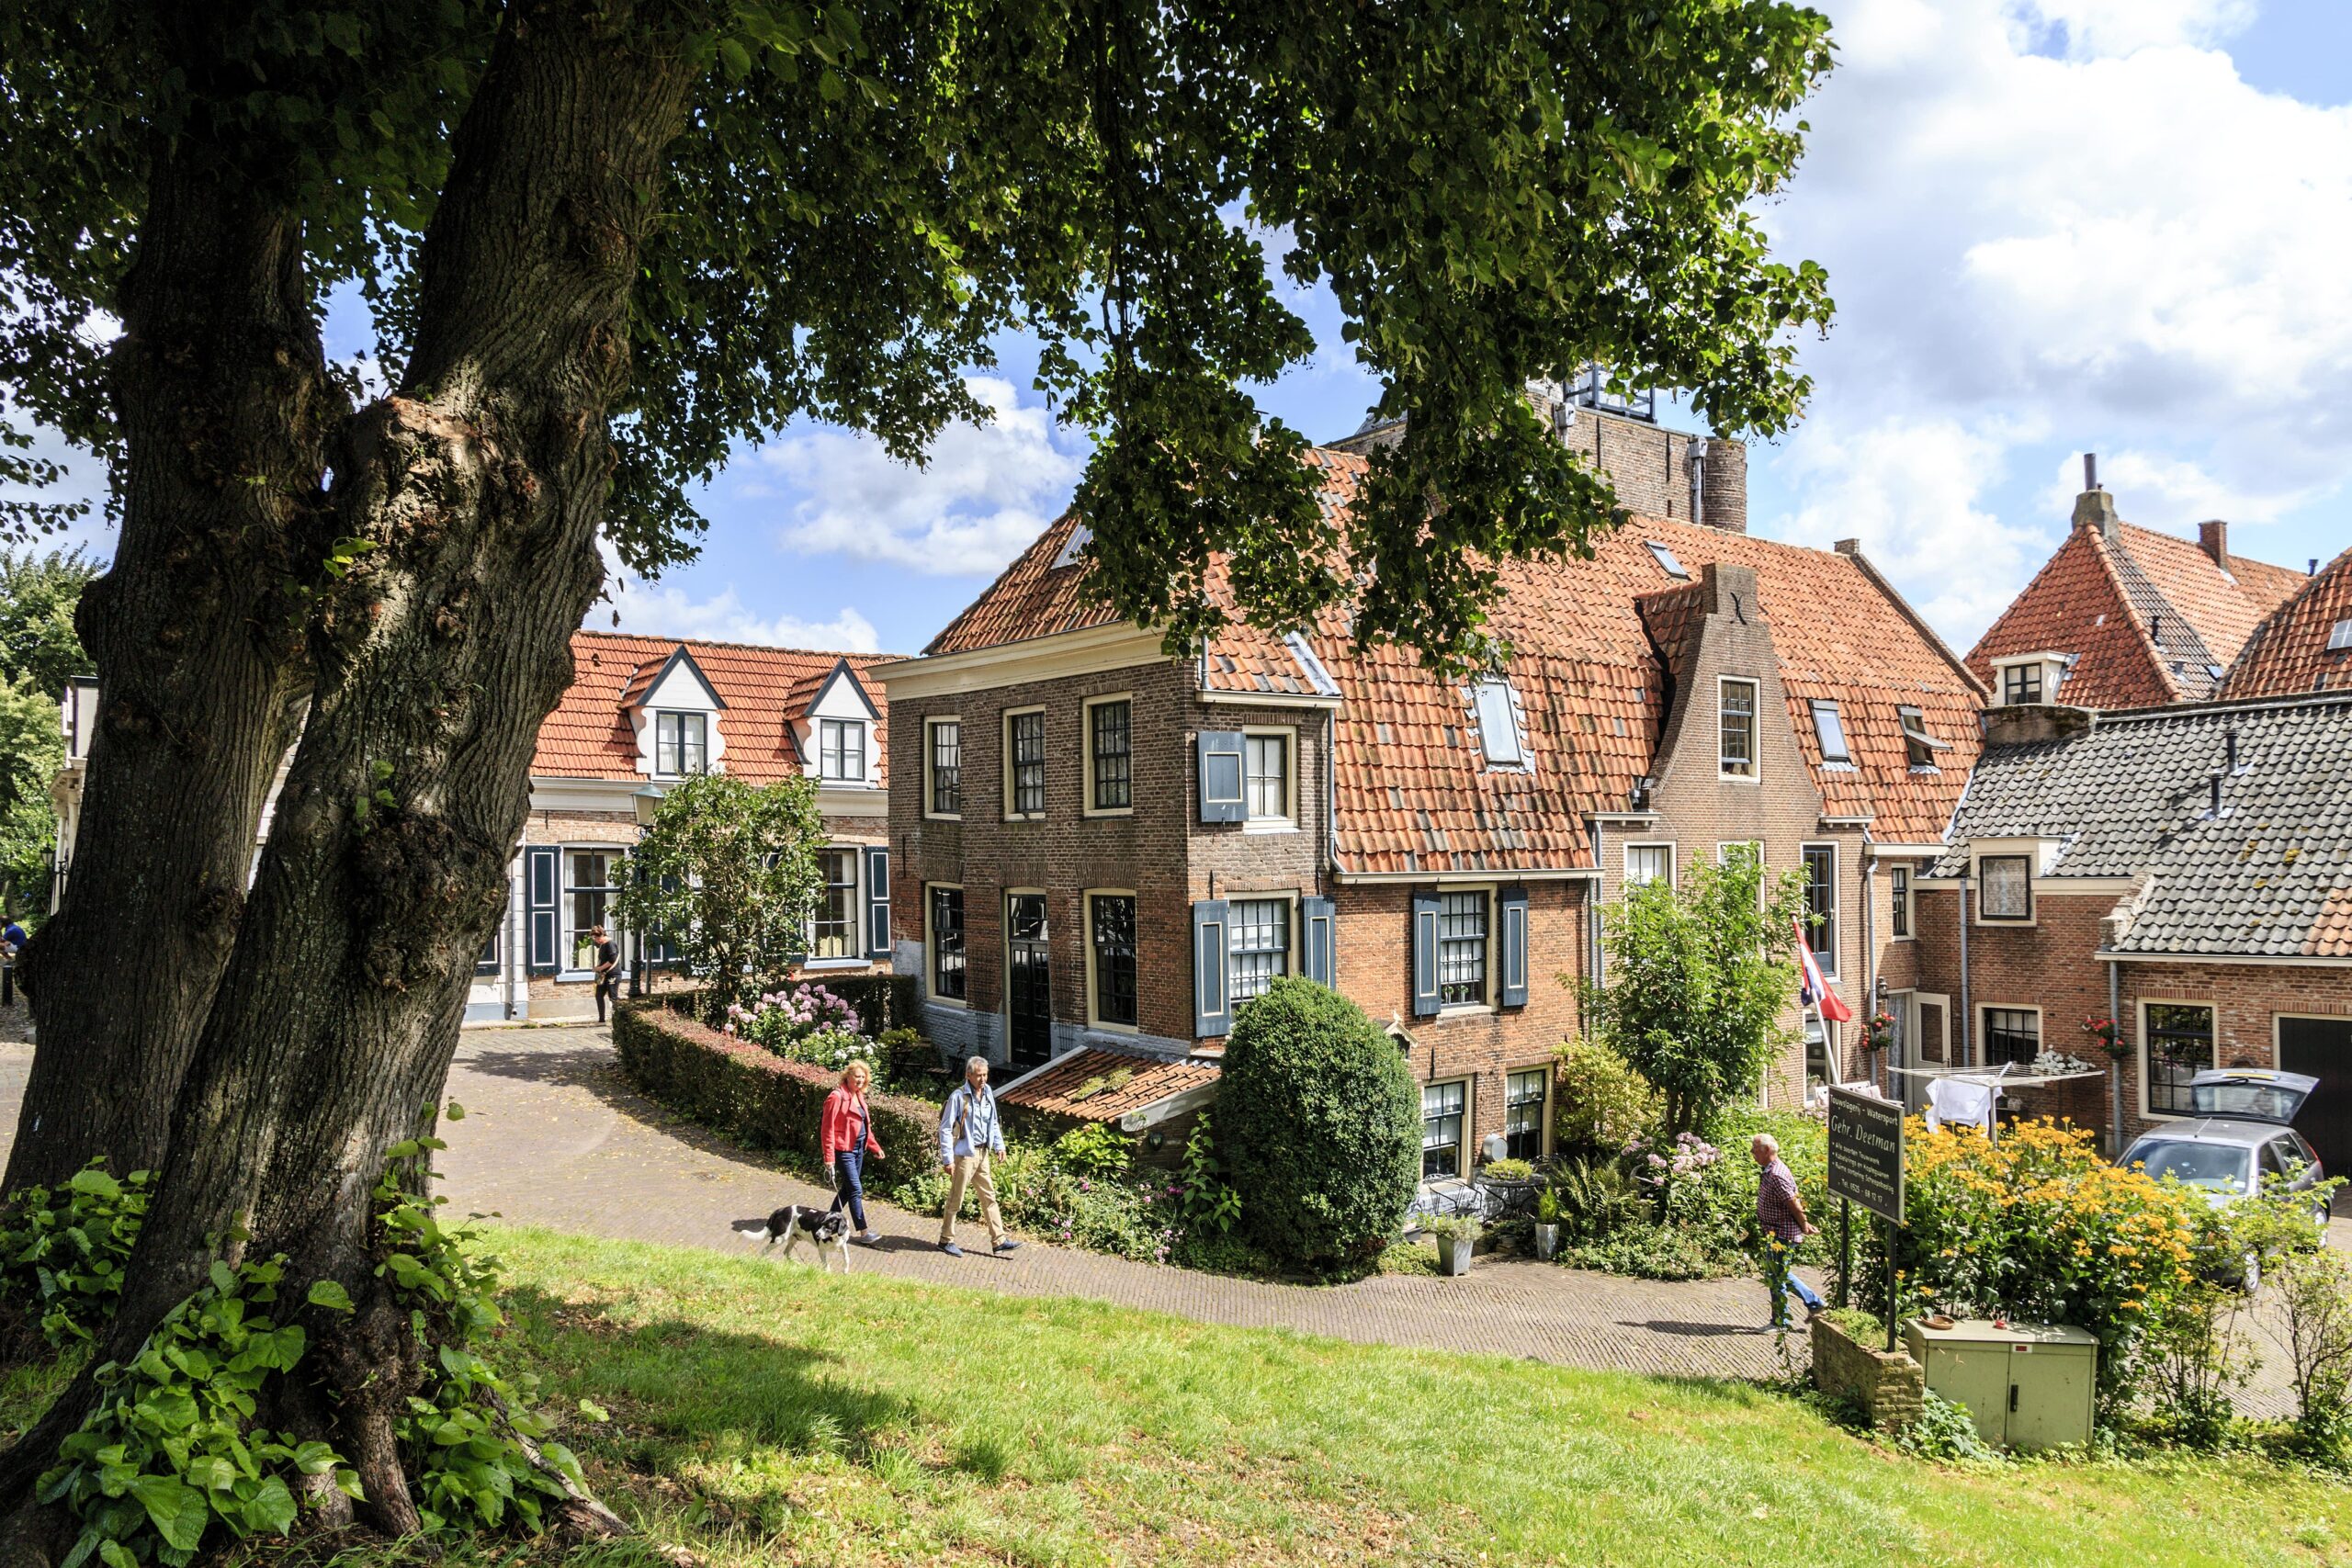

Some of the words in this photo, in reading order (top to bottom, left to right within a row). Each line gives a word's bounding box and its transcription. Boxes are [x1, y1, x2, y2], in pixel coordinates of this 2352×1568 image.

[1867, 1107, 1898, 1126] Watersport
[1831, 1114, 1852, 1138] Gebr.
[1856, 1123, 1895, 1154] Deetman
